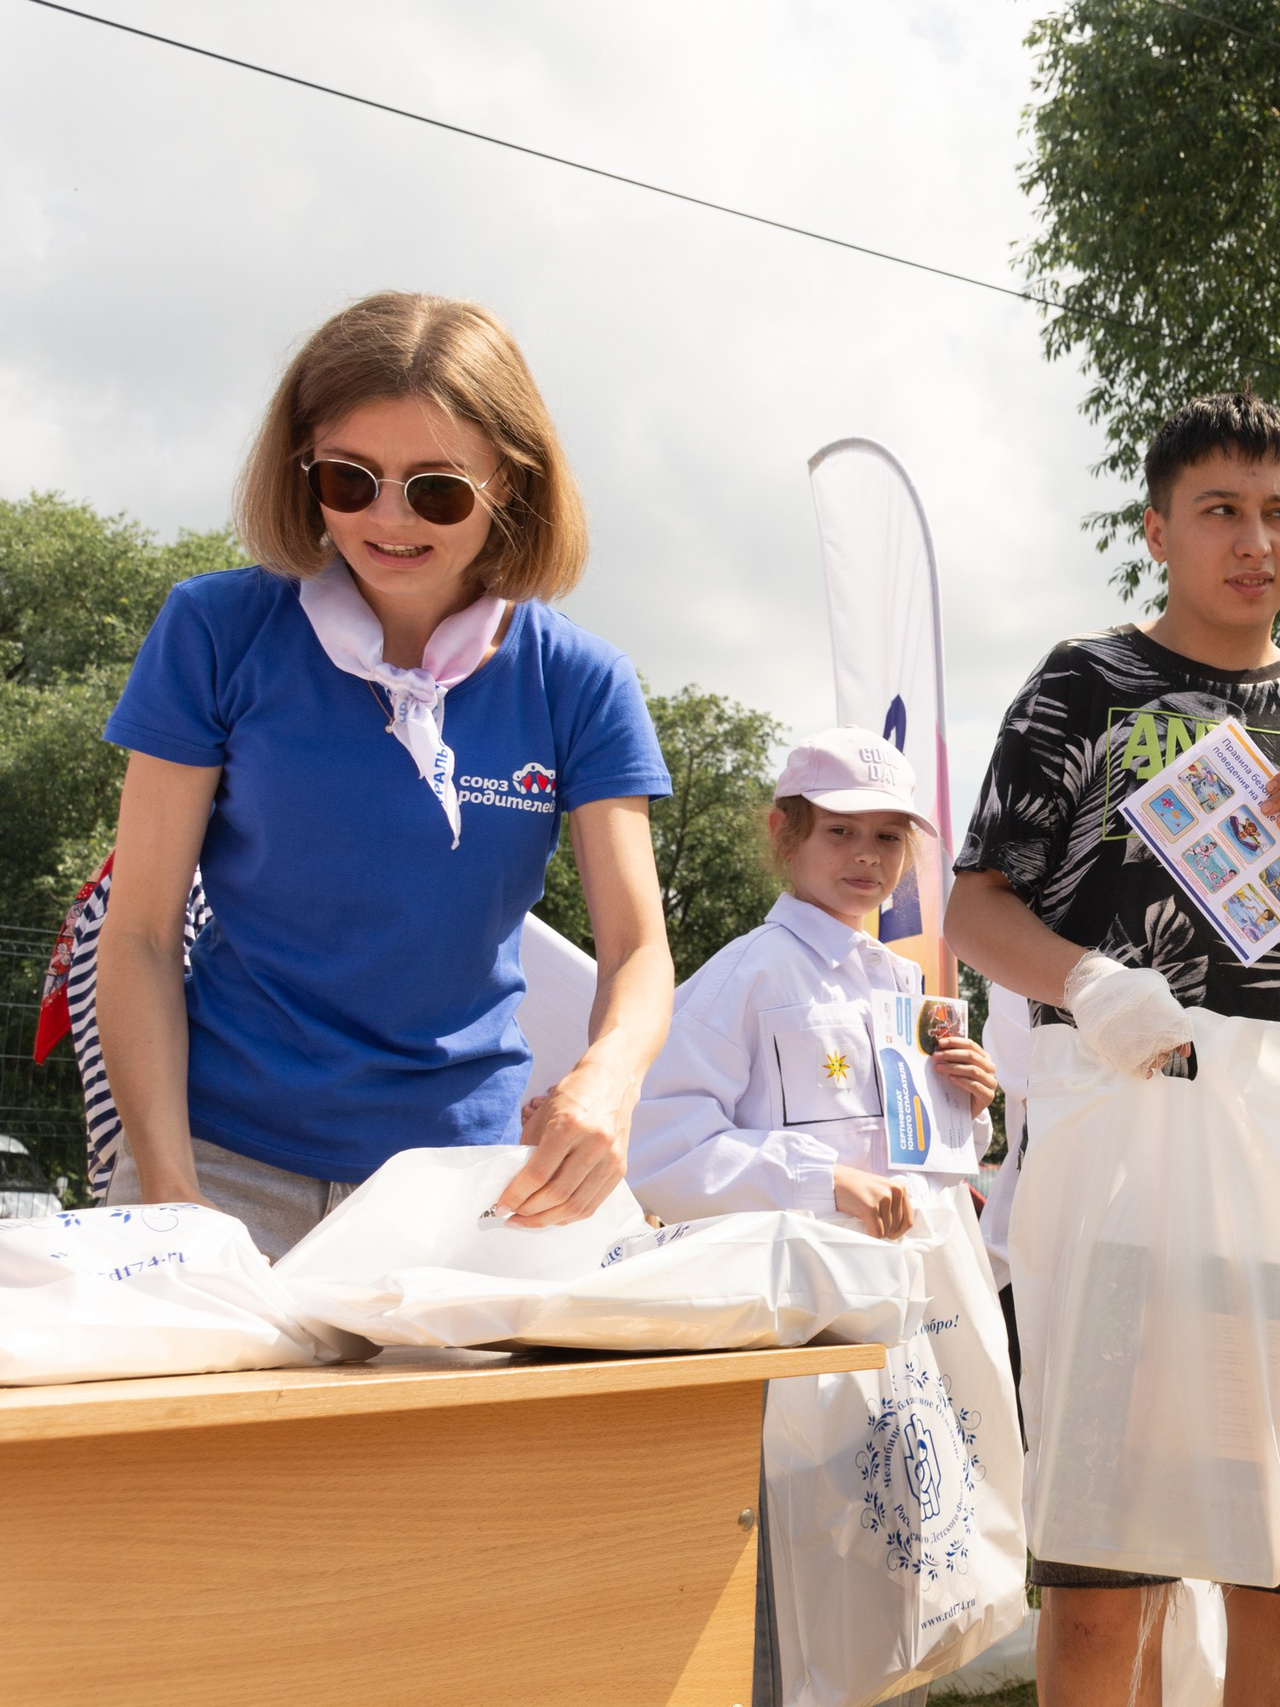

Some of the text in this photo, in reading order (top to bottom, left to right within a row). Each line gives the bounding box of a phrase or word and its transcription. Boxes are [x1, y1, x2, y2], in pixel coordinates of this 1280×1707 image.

[1213, 746, 1249, 790] поведения
[1248, 789, 1259, 801] на
[1222, 738, 1252, 775] Правила
[896, 1089, 907, 1150] СЕРТИФИКАТ
[898, 1061, 914, 1151] ЮНОГО СПАСАТЕЛЯ
